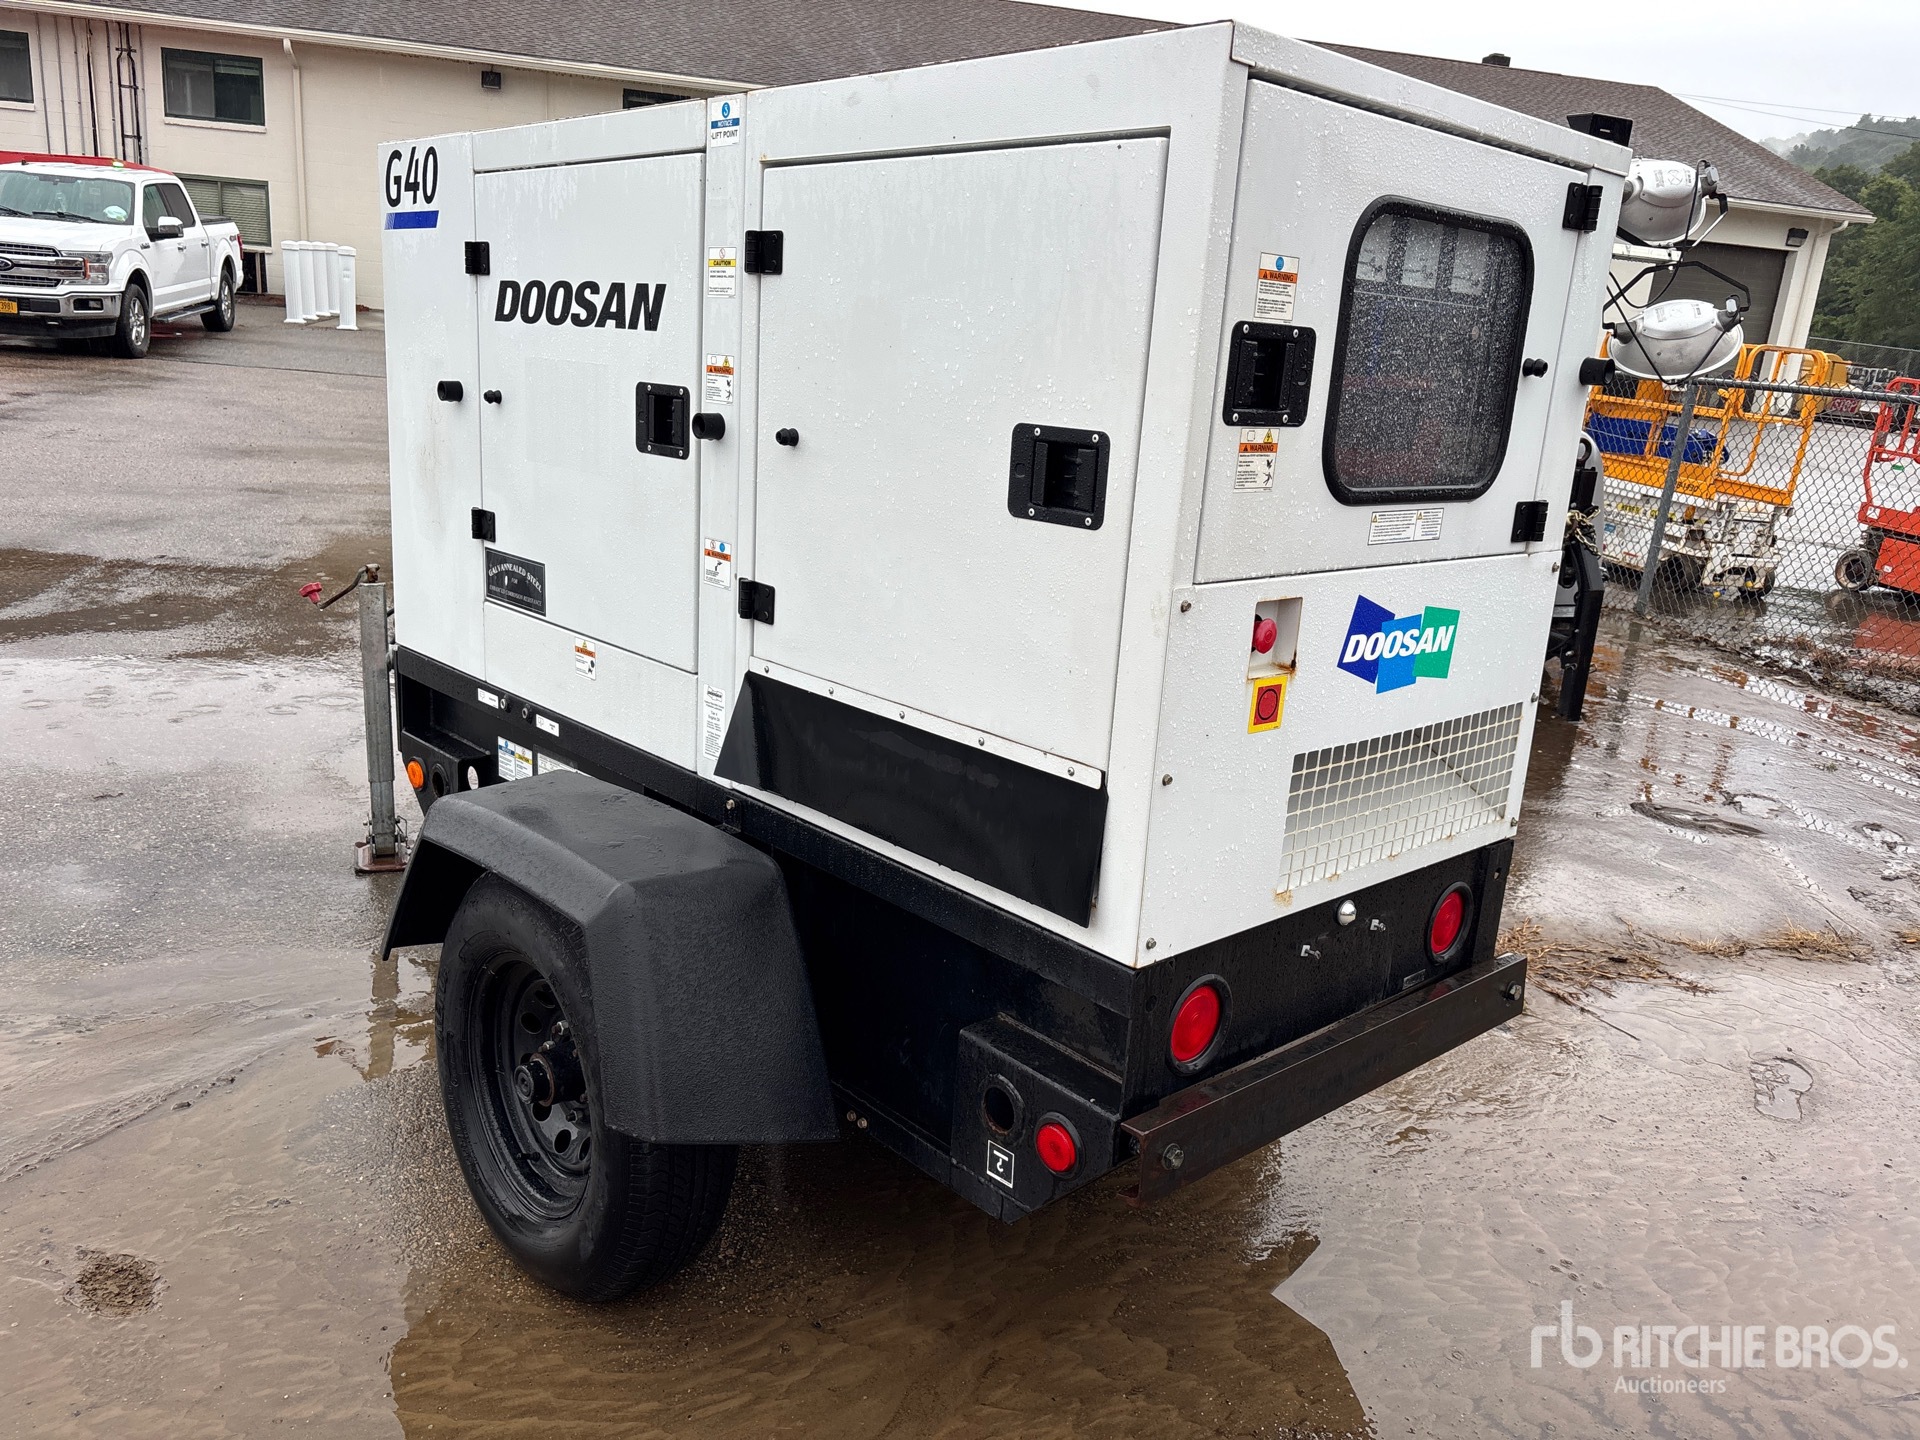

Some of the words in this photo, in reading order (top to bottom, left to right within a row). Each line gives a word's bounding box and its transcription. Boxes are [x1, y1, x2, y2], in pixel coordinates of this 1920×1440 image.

[723, 129, 738, 139] POINT
[385, 146, 439, 208] G40
[1269, 271, 1294, 282] WARNING
[494, 279, 667, 332] DOOSAN
[1832, 398, 1858, 412] STOP
[1250, 444, 1274, 452] WARNING
[526, 572, 542, 593] STEEL
[1342, 624, 1456, 664] DOOSAN
